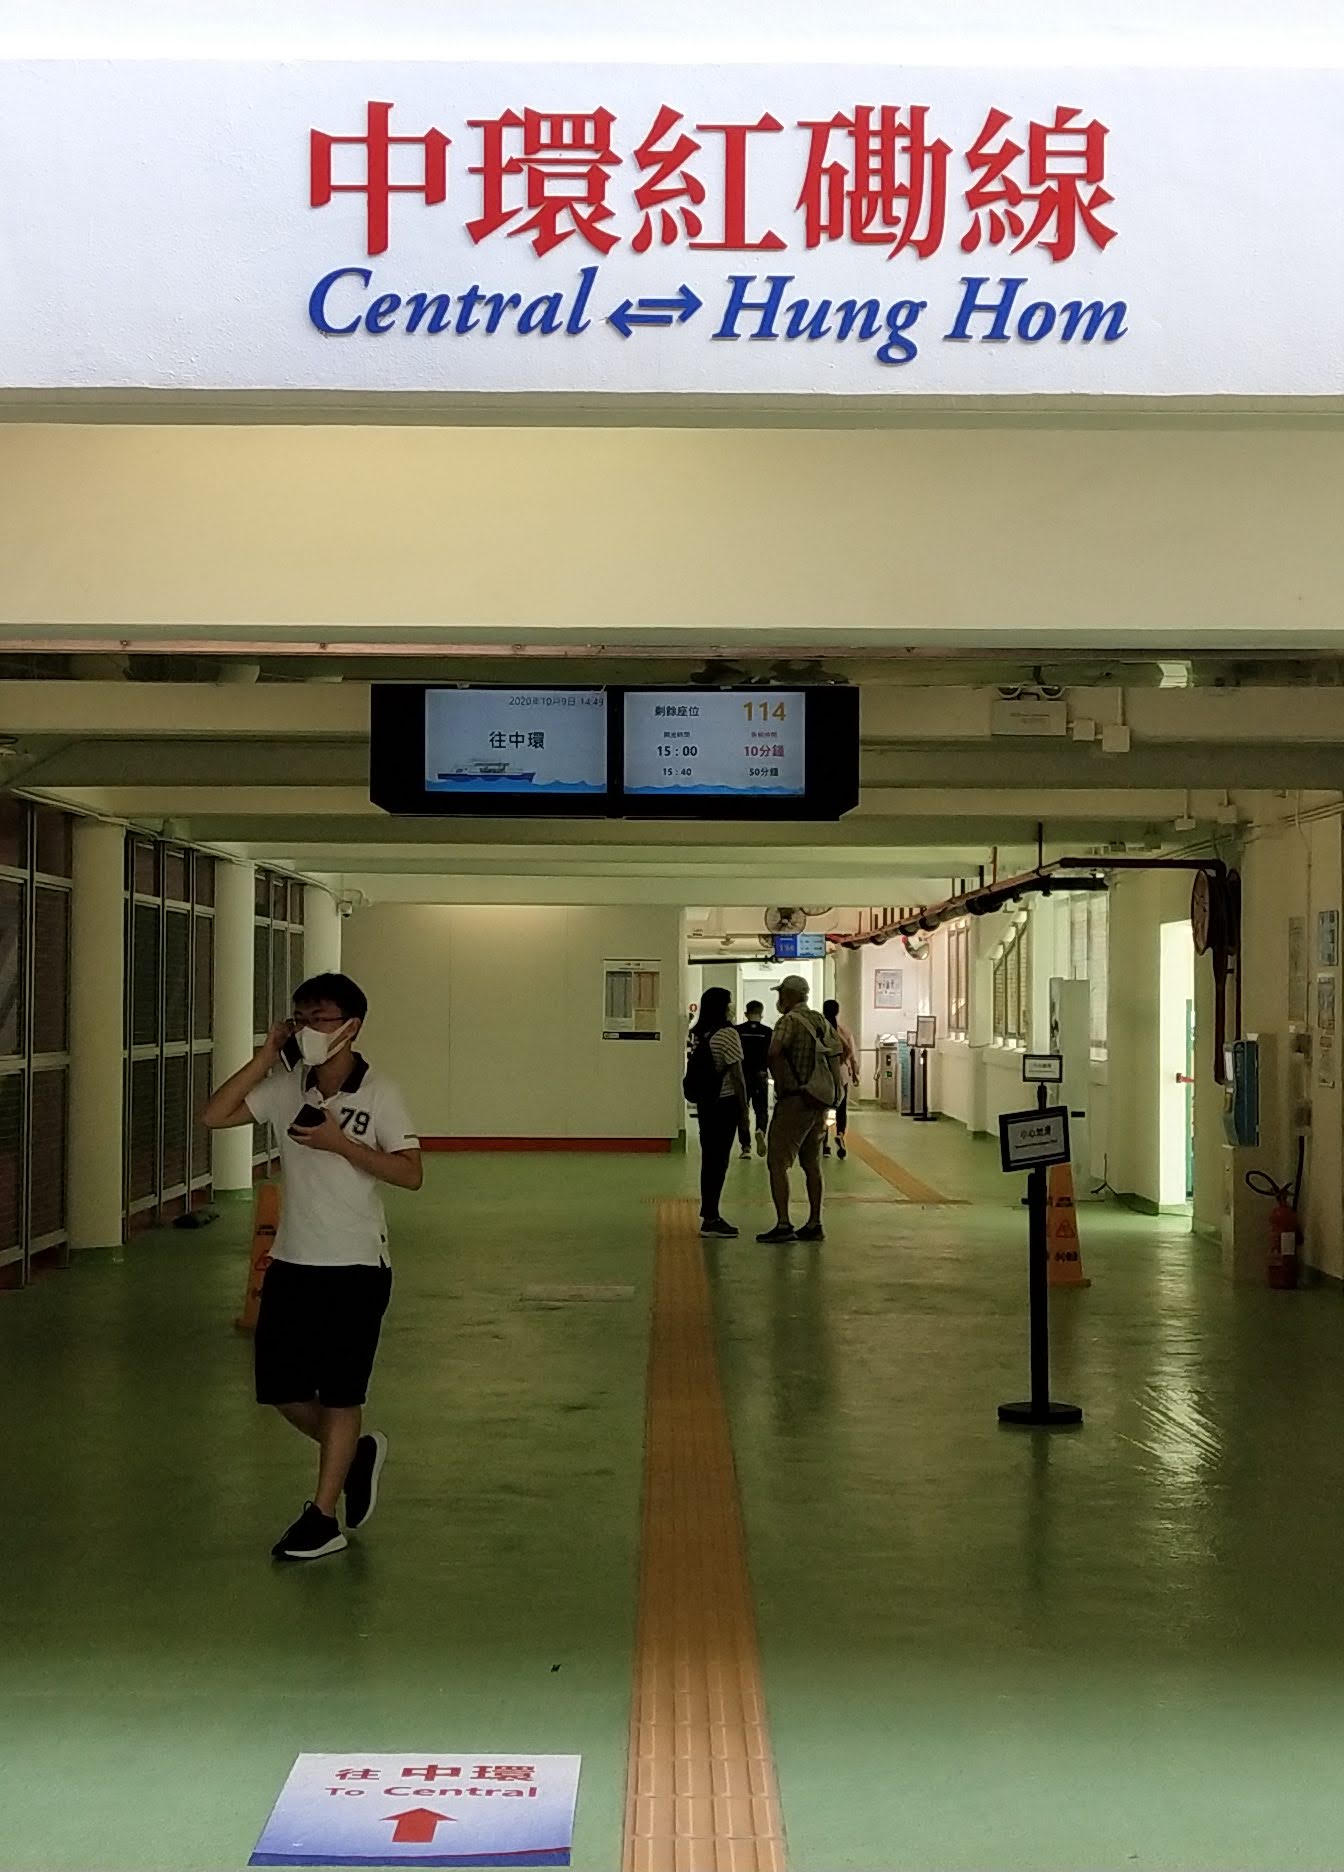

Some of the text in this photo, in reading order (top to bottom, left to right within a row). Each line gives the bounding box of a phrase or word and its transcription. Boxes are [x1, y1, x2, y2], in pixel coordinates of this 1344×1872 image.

[309, 101, 1119, 263] 中環紅磡線
[308, 267, 1131, 366] Central Hung Hom
[743, 701, 787, 722] 114
[488, 731, 545, 750] 往中環
[340, 1106, 371, 1136] 79
[325, 1786, 538, 1798] To Central
